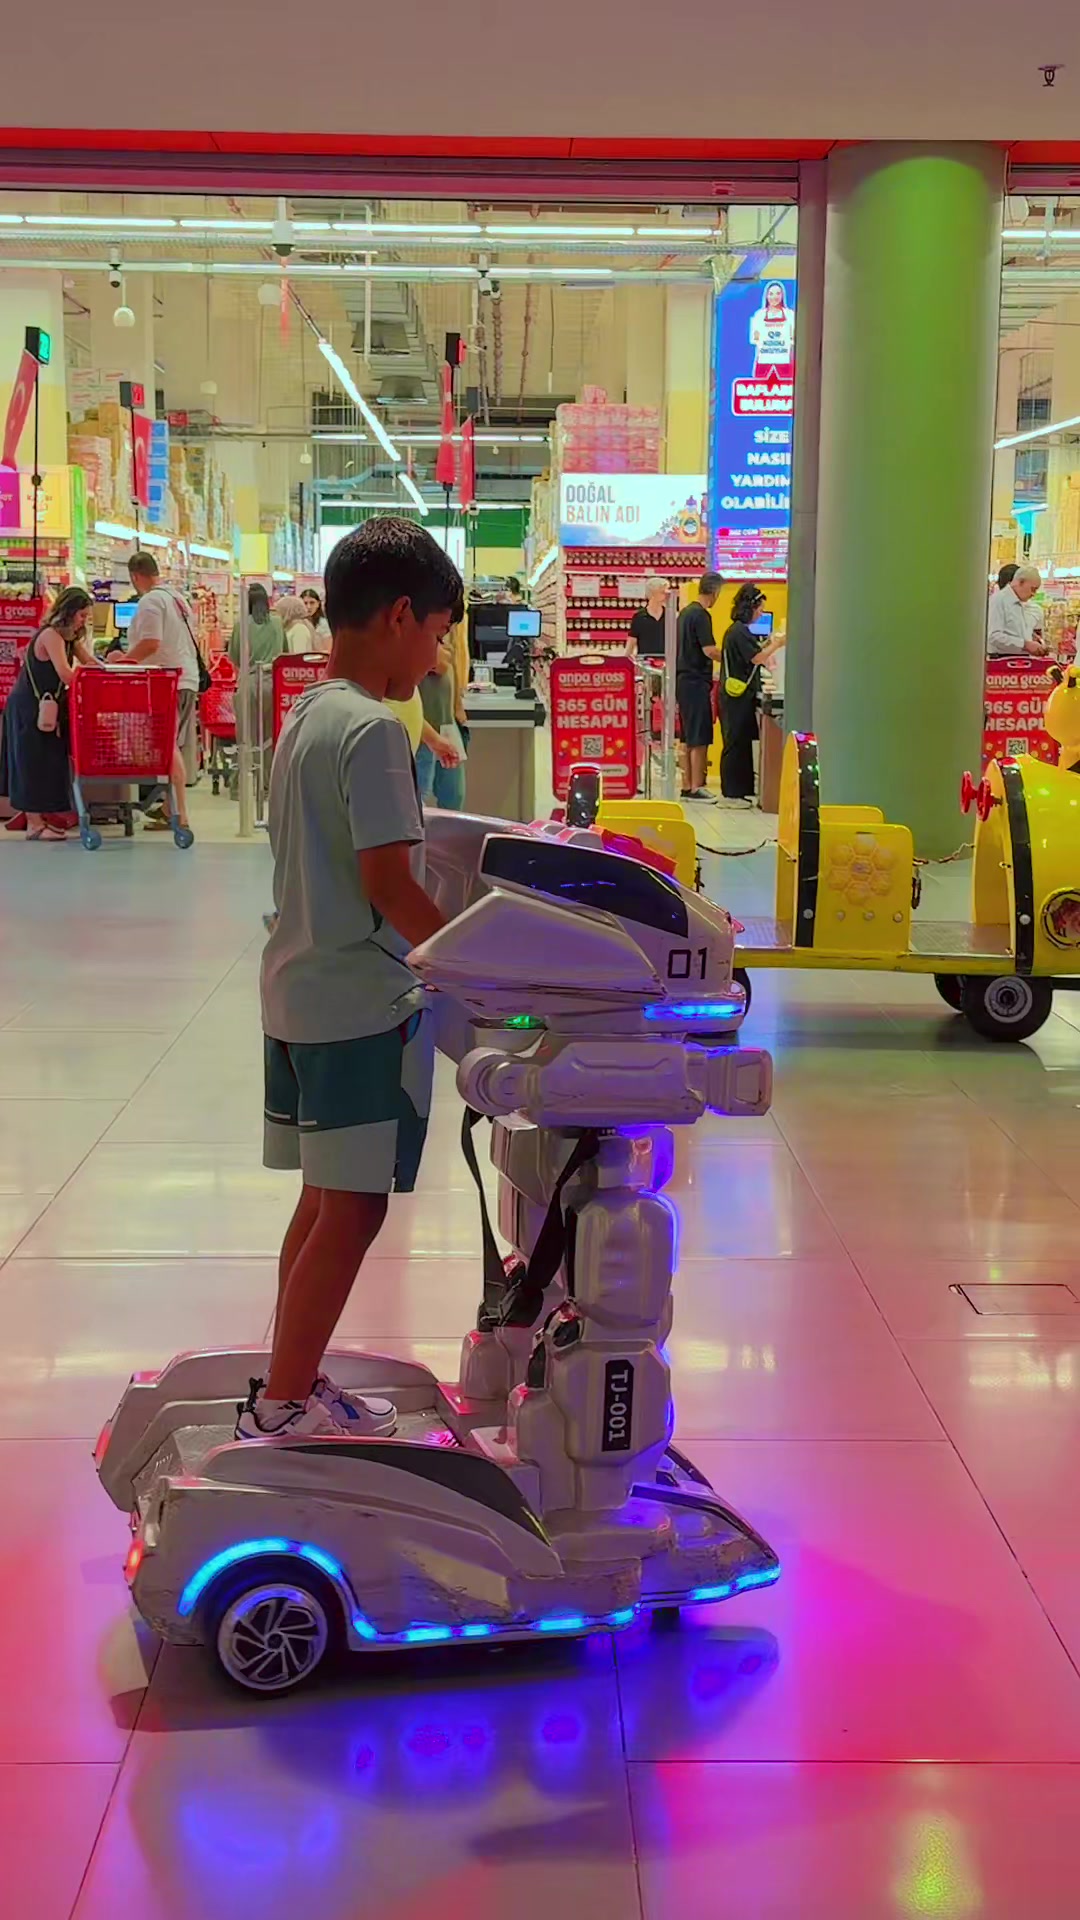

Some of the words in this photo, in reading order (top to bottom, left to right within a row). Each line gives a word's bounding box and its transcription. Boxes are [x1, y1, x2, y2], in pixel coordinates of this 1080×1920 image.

[566, 481, 616, 503] DOĞAL
[566, 505, 610, 523] BALIN
[615, 505, 640, 523] ADI
[281, 667, 316, 681] anpa
[558, 672, 591, 687] anpa
[592, 672, 625, 687] gross
[986, 675, 1018, 689] anpa
[1020, 675, 1053, 689] gross
[557, 698, 587, 712] 365
[591, 694, 628, 712] GÜN
[984, 701, 1013, 715] 365
[557, 715, 628, 729] HESAPLI
[667, 947, 708, 980] 01
[608, 1369, 629, 1442] TJ-001
